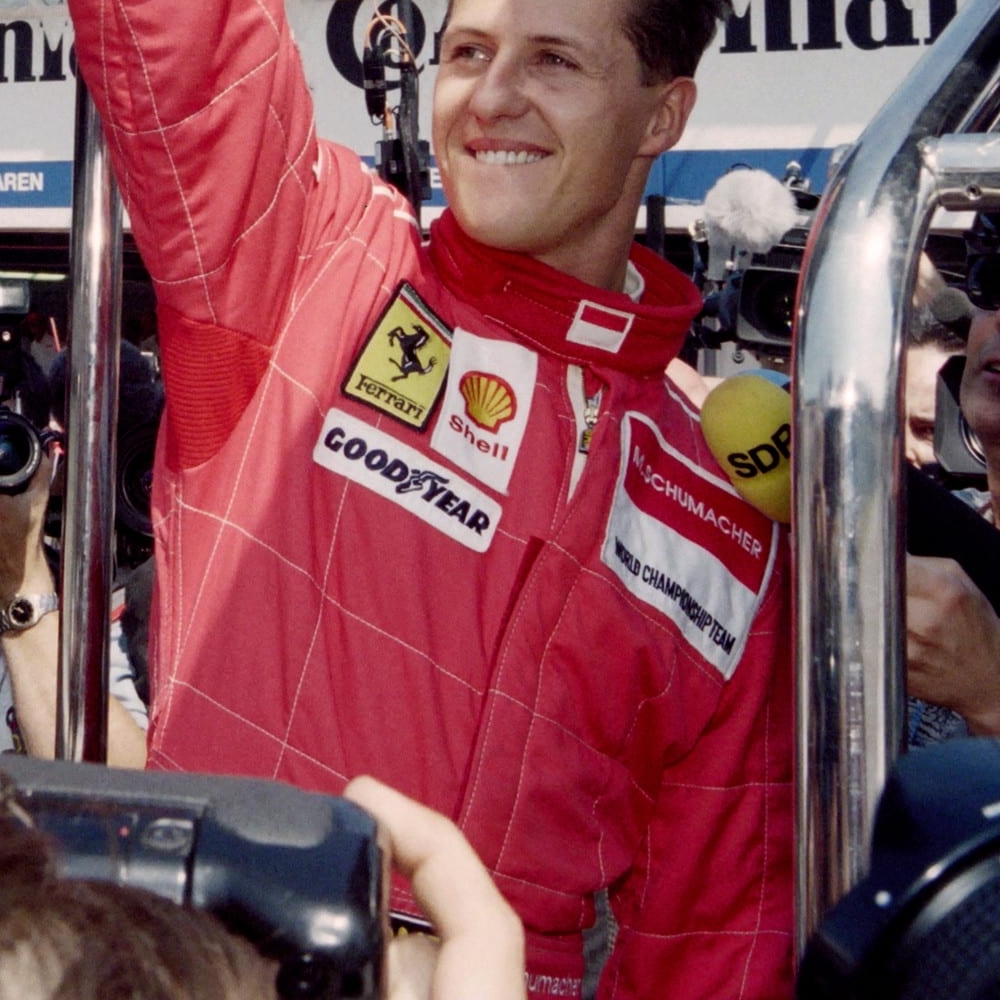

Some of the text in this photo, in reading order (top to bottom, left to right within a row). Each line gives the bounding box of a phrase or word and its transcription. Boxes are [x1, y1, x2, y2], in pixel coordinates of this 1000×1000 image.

[354, 374, 426, 420] Ferrari
[449, 413, 509, 461] Shell
[323, 426, 490, 536] GOODYEAR
[614, 535, 737, 656] WORLD CHAMPIONSHIP TEAM
